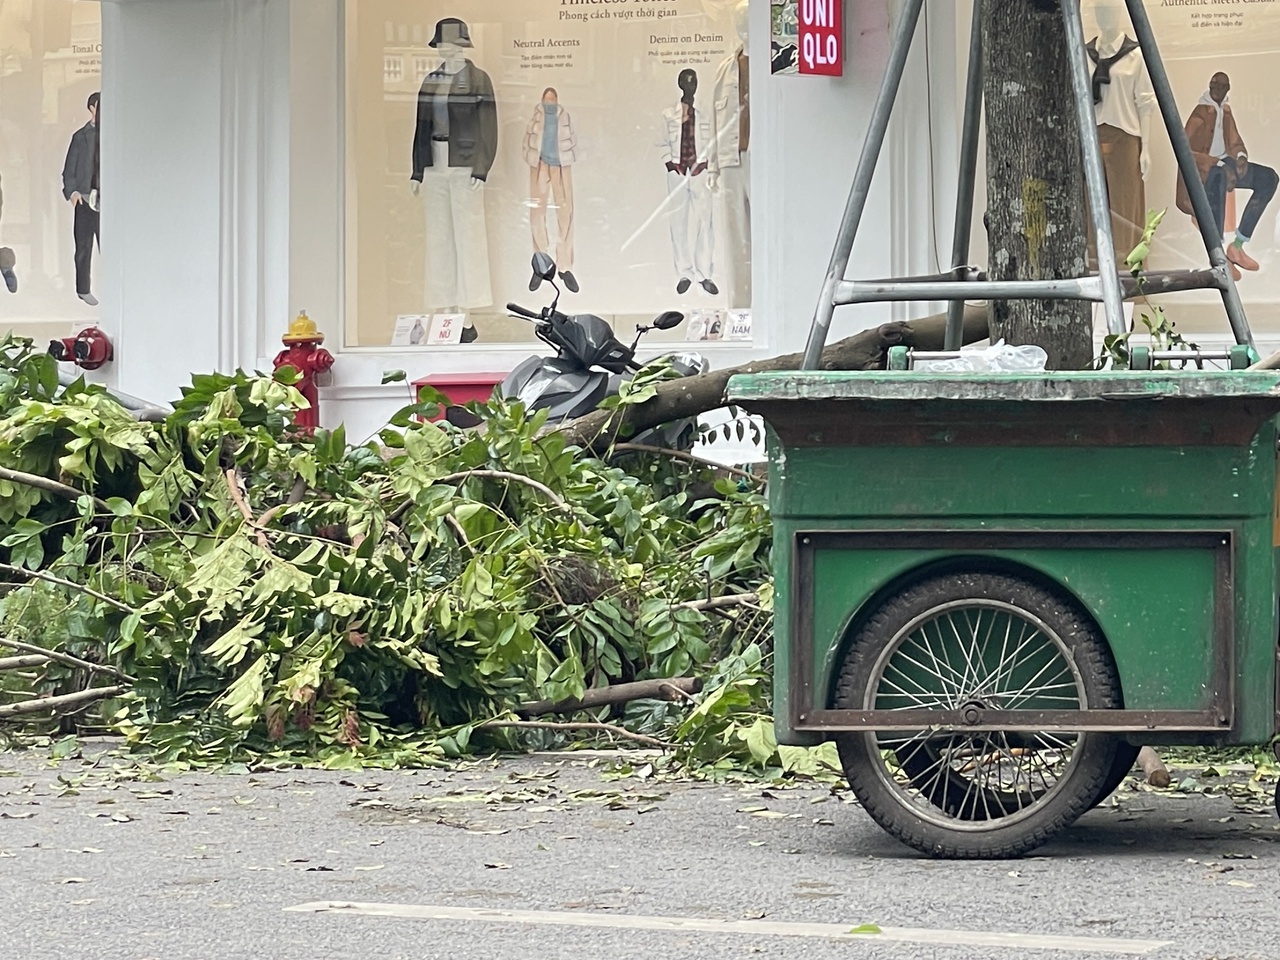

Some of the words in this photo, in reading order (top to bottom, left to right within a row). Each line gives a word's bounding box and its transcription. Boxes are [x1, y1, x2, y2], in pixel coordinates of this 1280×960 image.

[559, 9, 589, 22] Phong
[590, 8, 611, 19] cách
[613, 10, 634, 20] vượt
[636, 7, 655, 18] thời
[657, 7, 678, 20] gian
[513, 38, 545, 49] Neutral
[547, 38, 581, 48] Accents
[649, 34, 679, 45] Denim
[680, 35, 692, 43] on
[694, 32, 724, 43] Denim
[71, 43, 94, 54] Tonal
[803, 32, 838, 69] QLO
